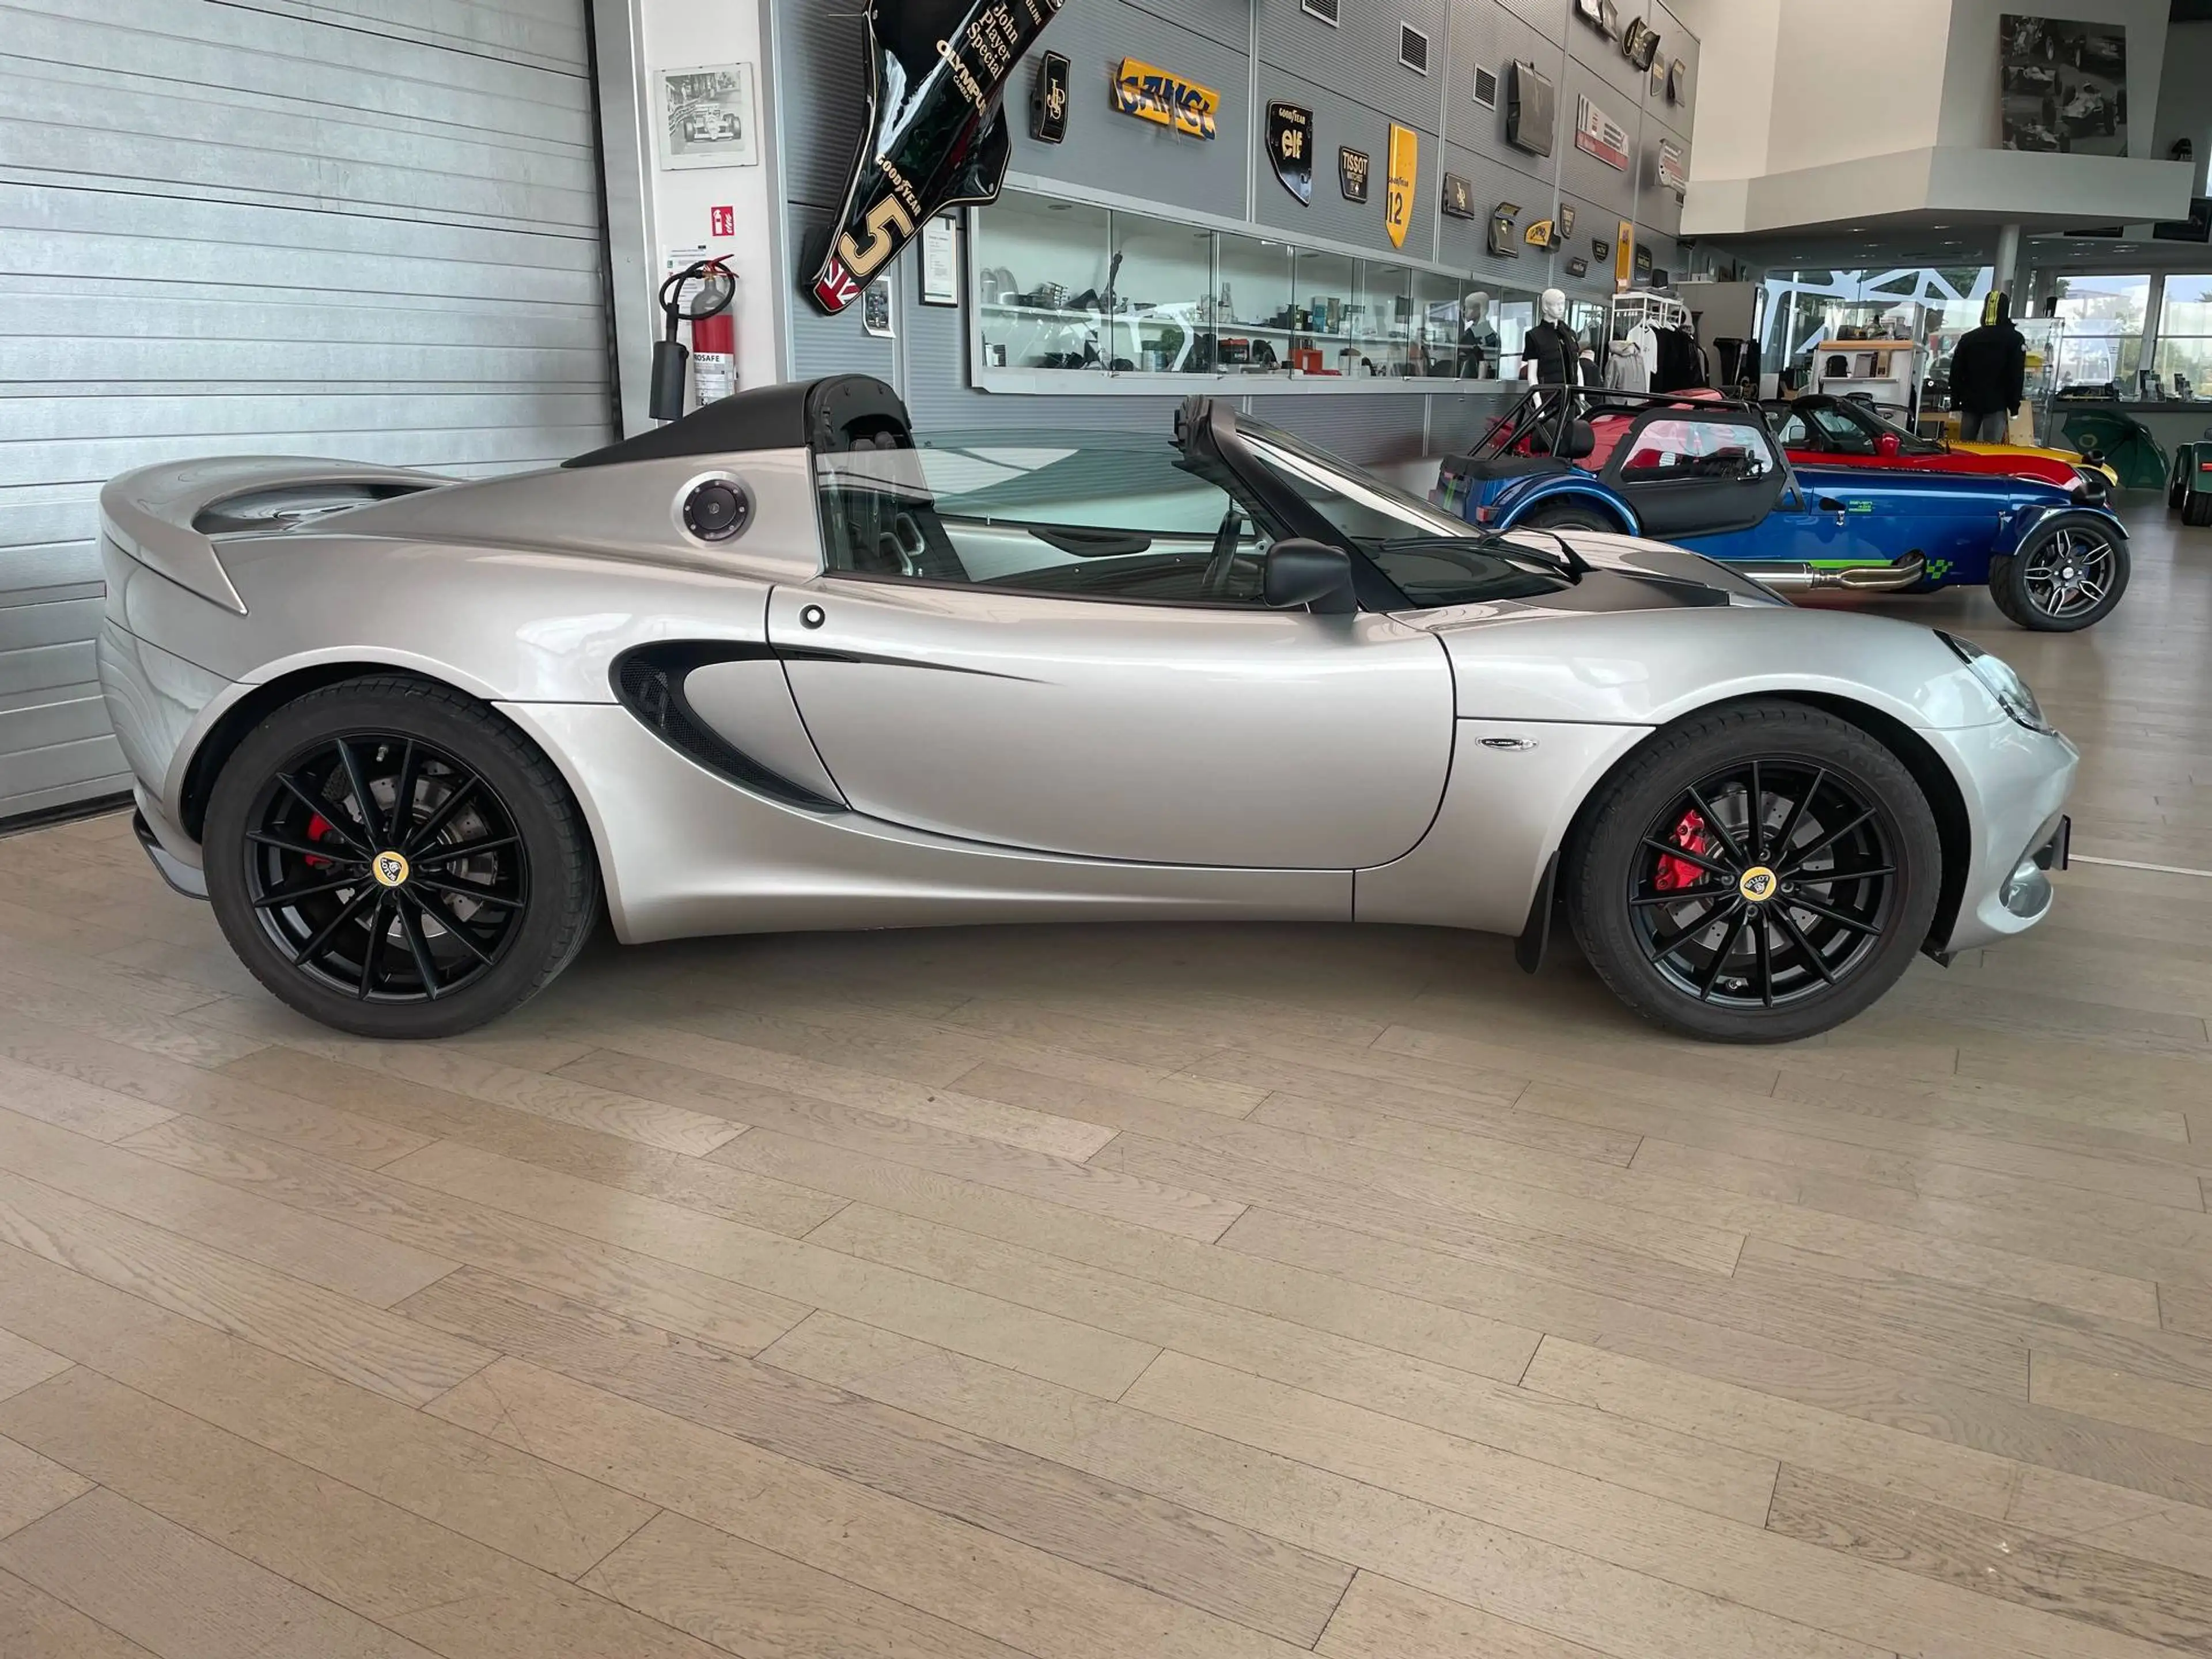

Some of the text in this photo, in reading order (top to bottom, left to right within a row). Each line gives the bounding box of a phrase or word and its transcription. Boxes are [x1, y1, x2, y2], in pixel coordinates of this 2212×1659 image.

[979, 9, 1012, 63] Player
[994, 3, 1019, 44] John
[967, 21, 1004, 81] Special
[936, 39, 987, 117] OLYMPUS
[1279, 108, 1306, 125] GOODYEAR
[1282, 129, 1304, 159] elf
[1343, 151, 1368, 175] TISSOT
[875, 153, 922, 217] GOODYEAR
[1389, 192, 1403, 225] 12
[838, 194, 915, 278] 5
[381, 859, 396, 881] LOTUS
[1745, 876, 1769, 888] LOTUS
